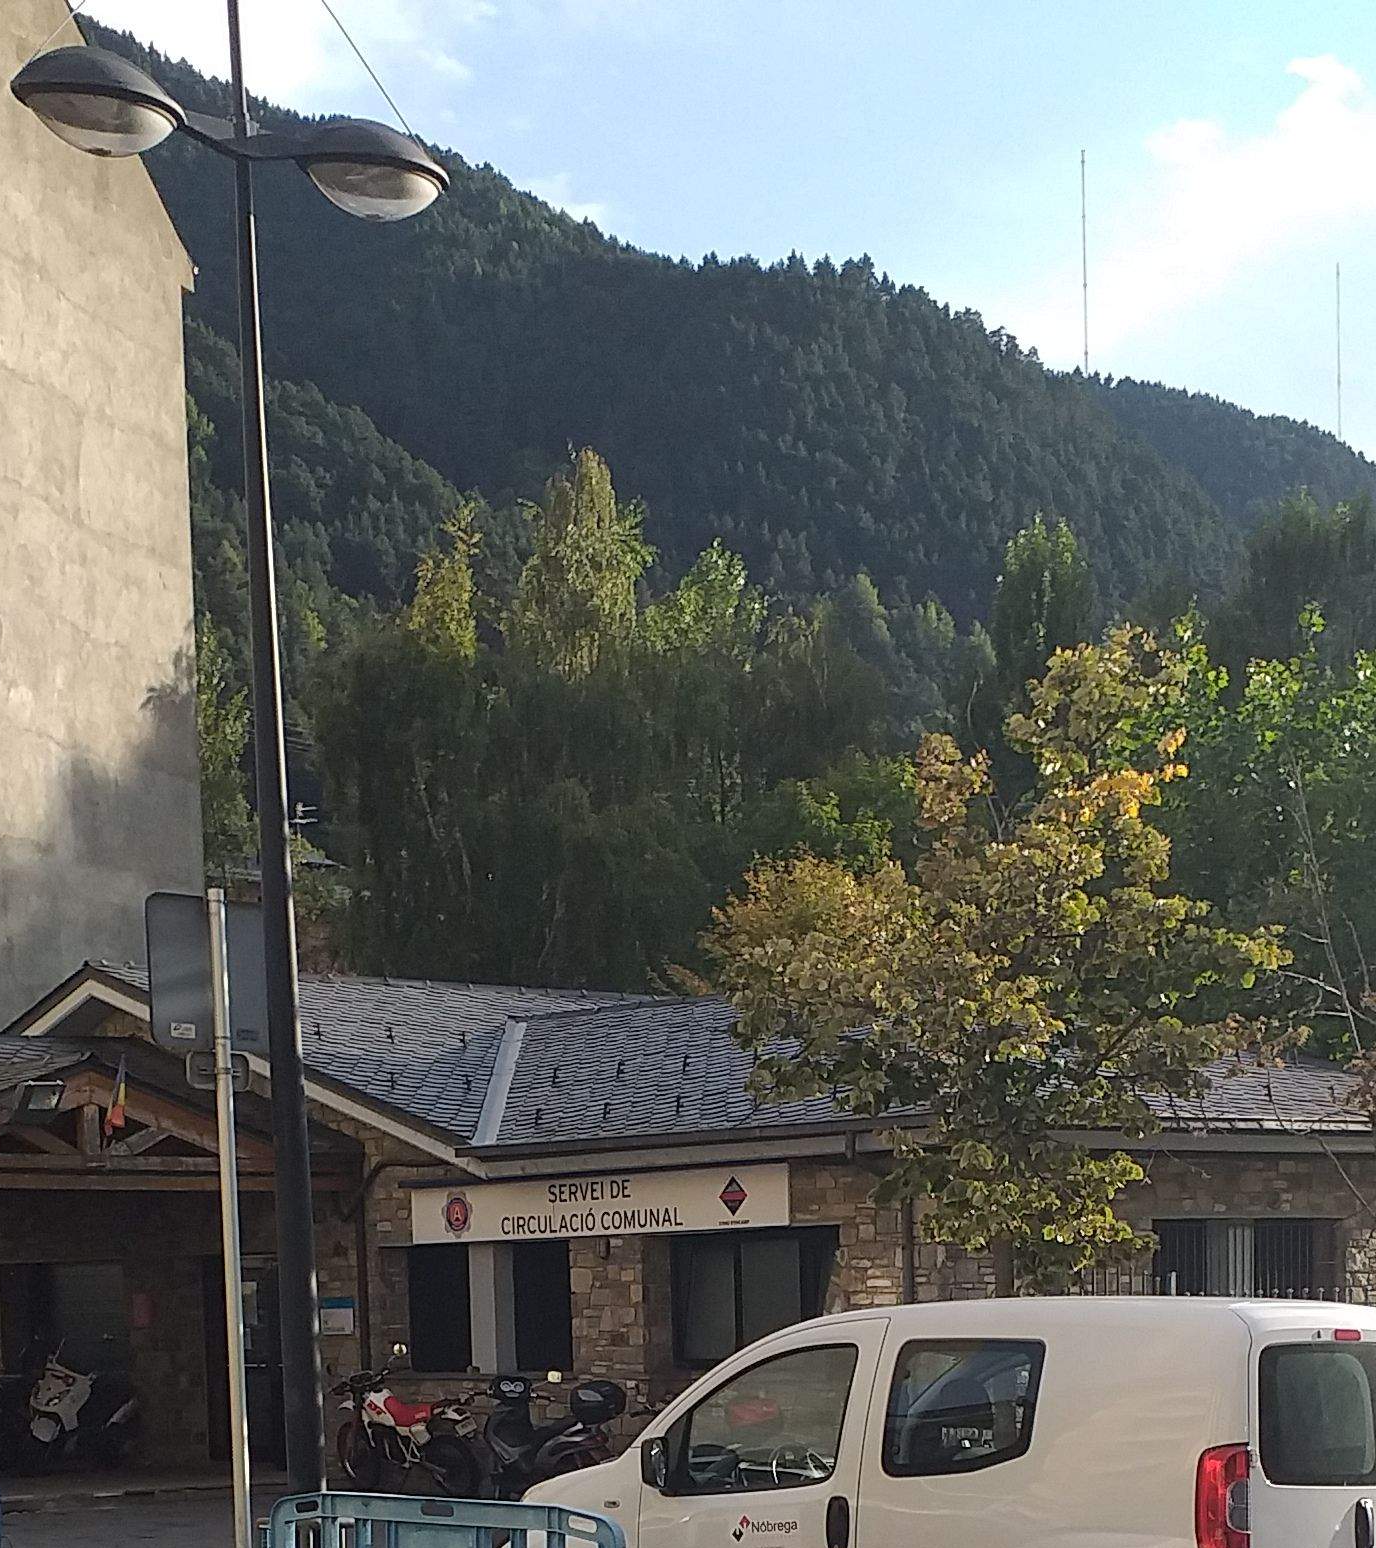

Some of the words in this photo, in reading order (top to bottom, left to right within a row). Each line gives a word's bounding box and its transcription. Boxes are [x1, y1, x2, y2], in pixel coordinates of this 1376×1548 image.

[548, 1180, 605, 1203] SERVEI
[611, 1179, 631, 1199] DE
[501, 1208, 595, 1235] CIRCULACIÓ
[601, 1206, 683, 1230] COMUNAL
